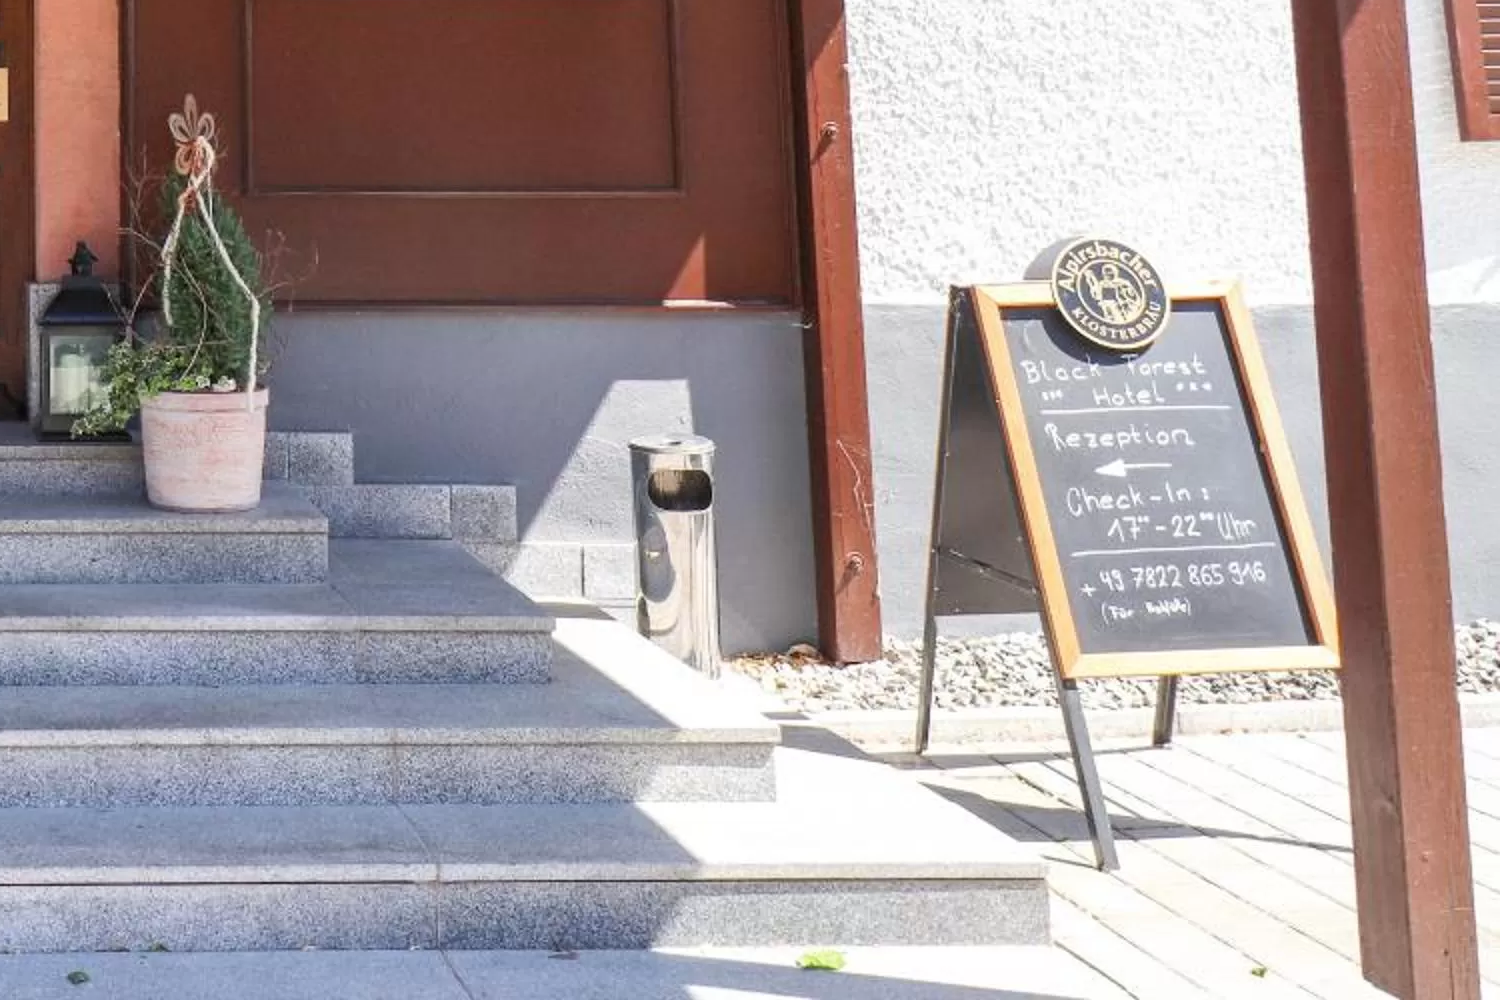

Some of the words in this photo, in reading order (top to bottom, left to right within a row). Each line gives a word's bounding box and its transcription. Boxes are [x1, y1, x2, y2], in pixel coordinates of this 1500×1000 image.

[1058, 241, 1158, 293] Alpirsbacher
[1092, 380, 1166, 406] Hotel
[1044, 423, 1197, 450] Rezeption
[1131, 564, 1184, 590] 7822
[1187, 562, 1225, 586] 865
[1227, 560, 1267, 585] 916
